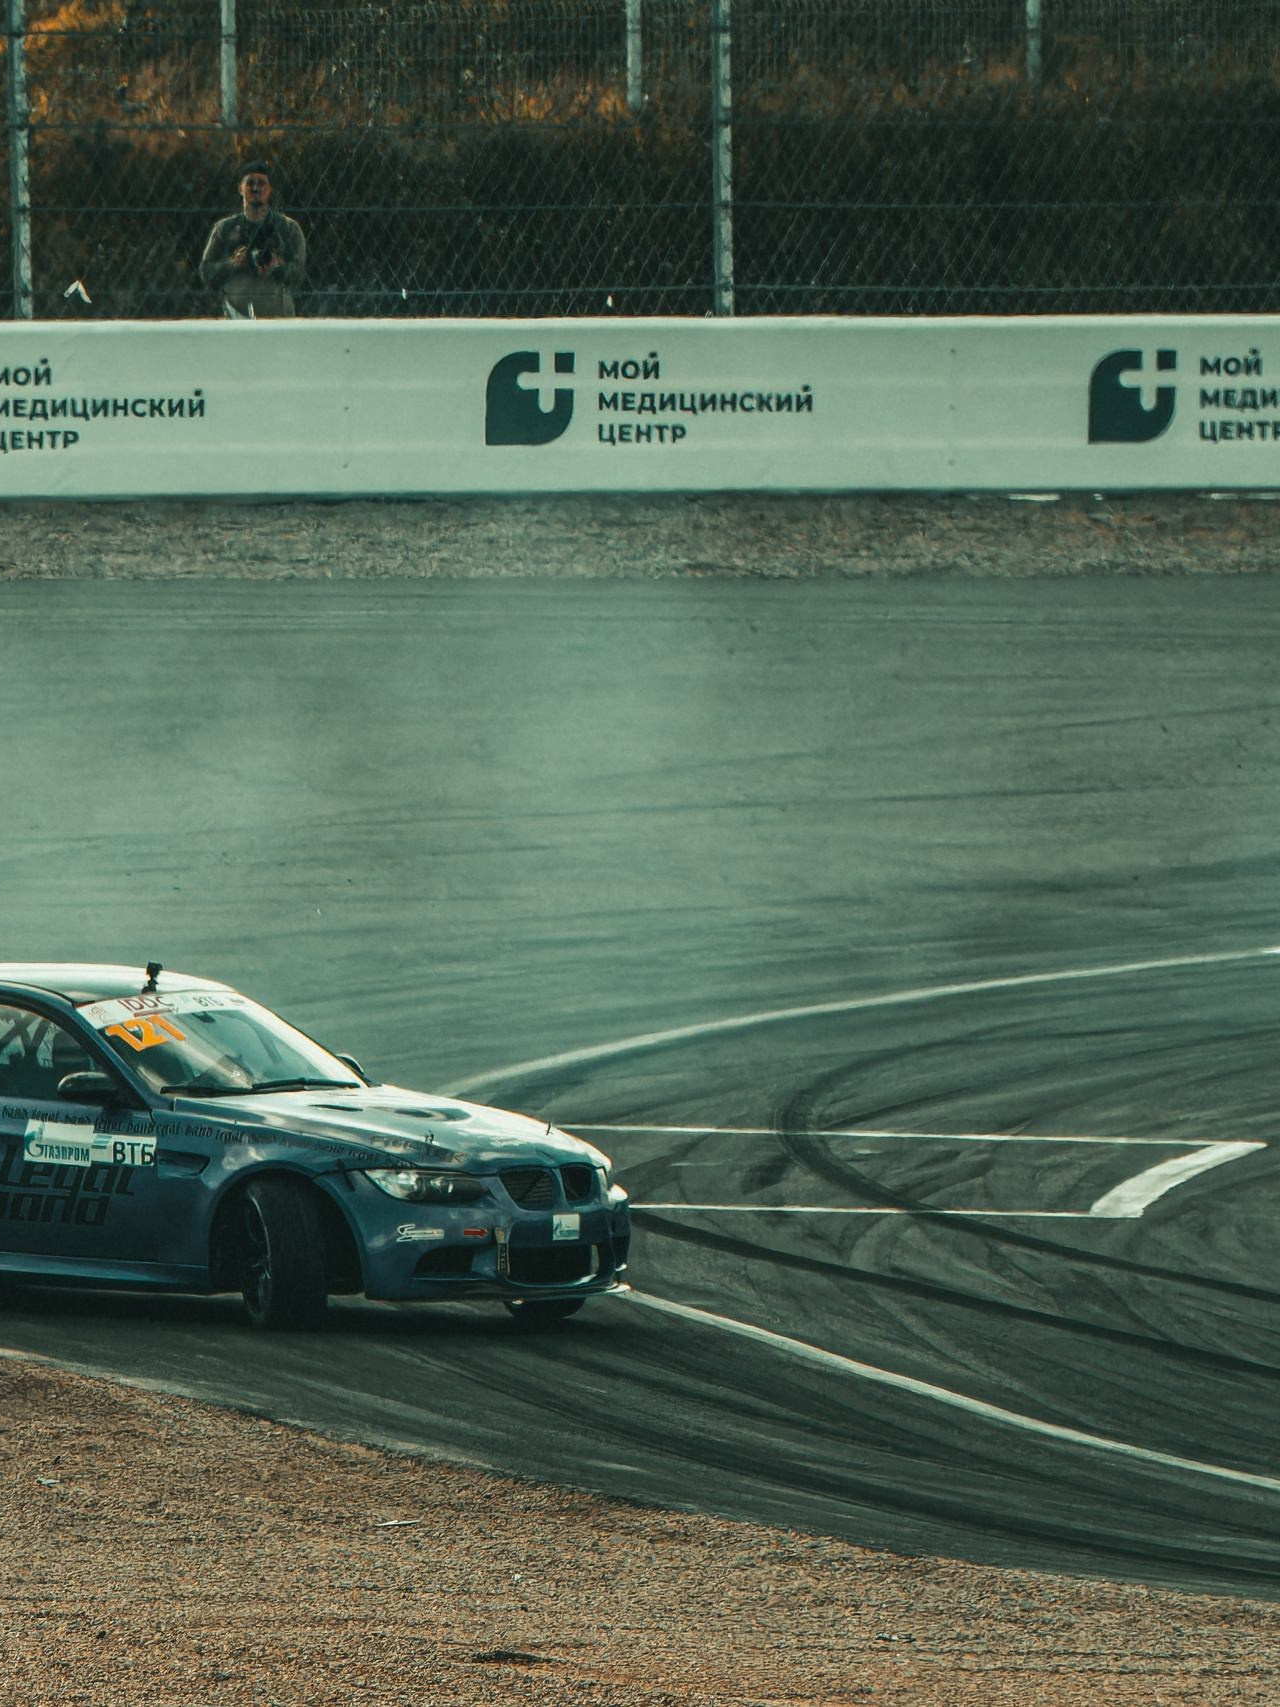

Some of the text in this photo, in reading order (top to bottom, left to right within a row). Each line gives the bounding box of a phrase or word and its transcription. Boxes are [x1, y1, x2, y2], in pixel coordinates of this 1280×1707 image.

[598, 352, 660, 380] МОЙ
[1199, 347, 1263, 377] МОЙ
[598, 384, 813, 415] МЕДИЦИНСКИЙ
[1199, 387, 1280, 413] МЕДИ
[598, 424, 687, 446] ЦЕНТР
[105, 1014, 187, 1053] 121
[44, 1145, 90, 1162] ГАЗПРОМ
[113, 1141, 155, 1165] ВТБ
